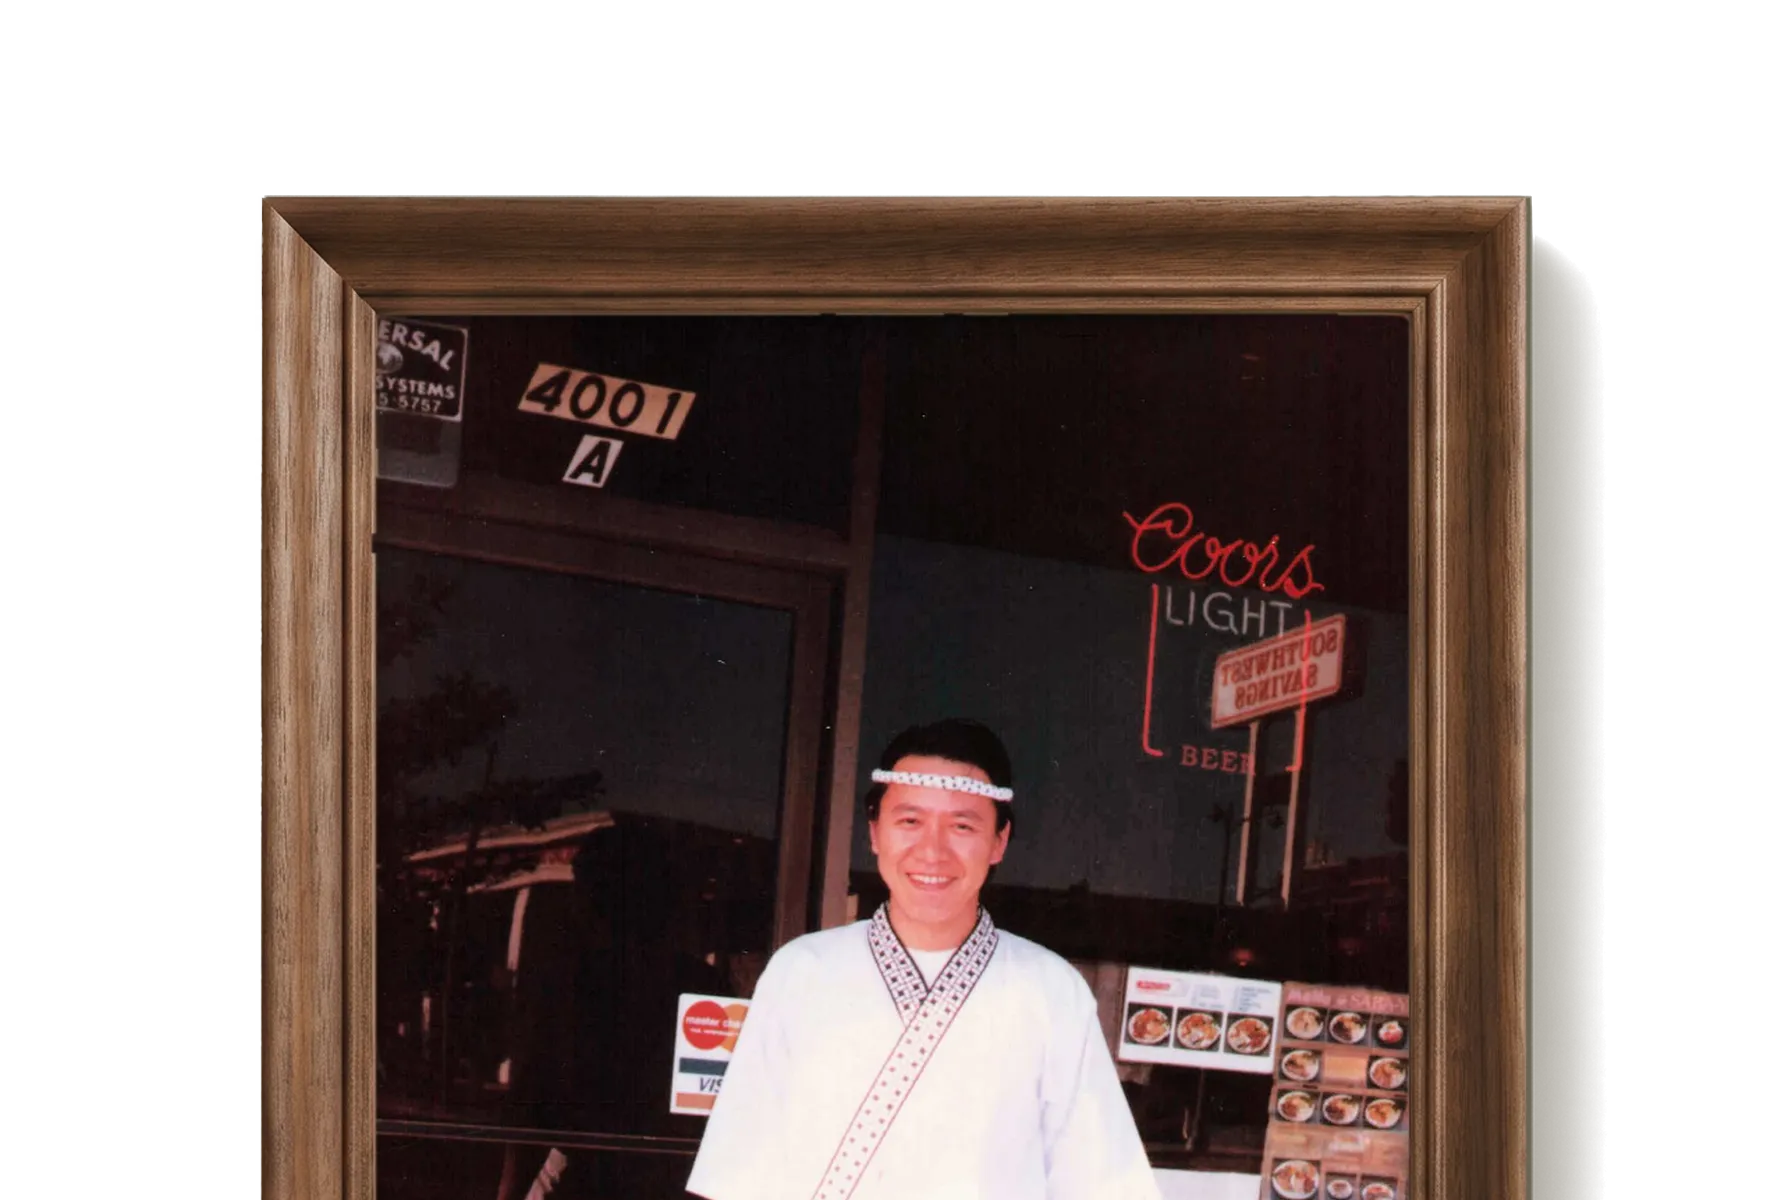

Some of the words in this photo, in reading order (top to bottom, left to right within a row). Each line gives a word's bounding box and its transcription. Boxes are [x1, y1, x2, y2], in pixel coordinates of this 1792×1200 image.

[379, 319, 454, 371] ERSAL
[525, 369, 682, 434] 4001
[569, 440, 612, 484] A
[1123, 503, 1324, 598] Coors
[1166, 585, 1293, 639] LIGHT
